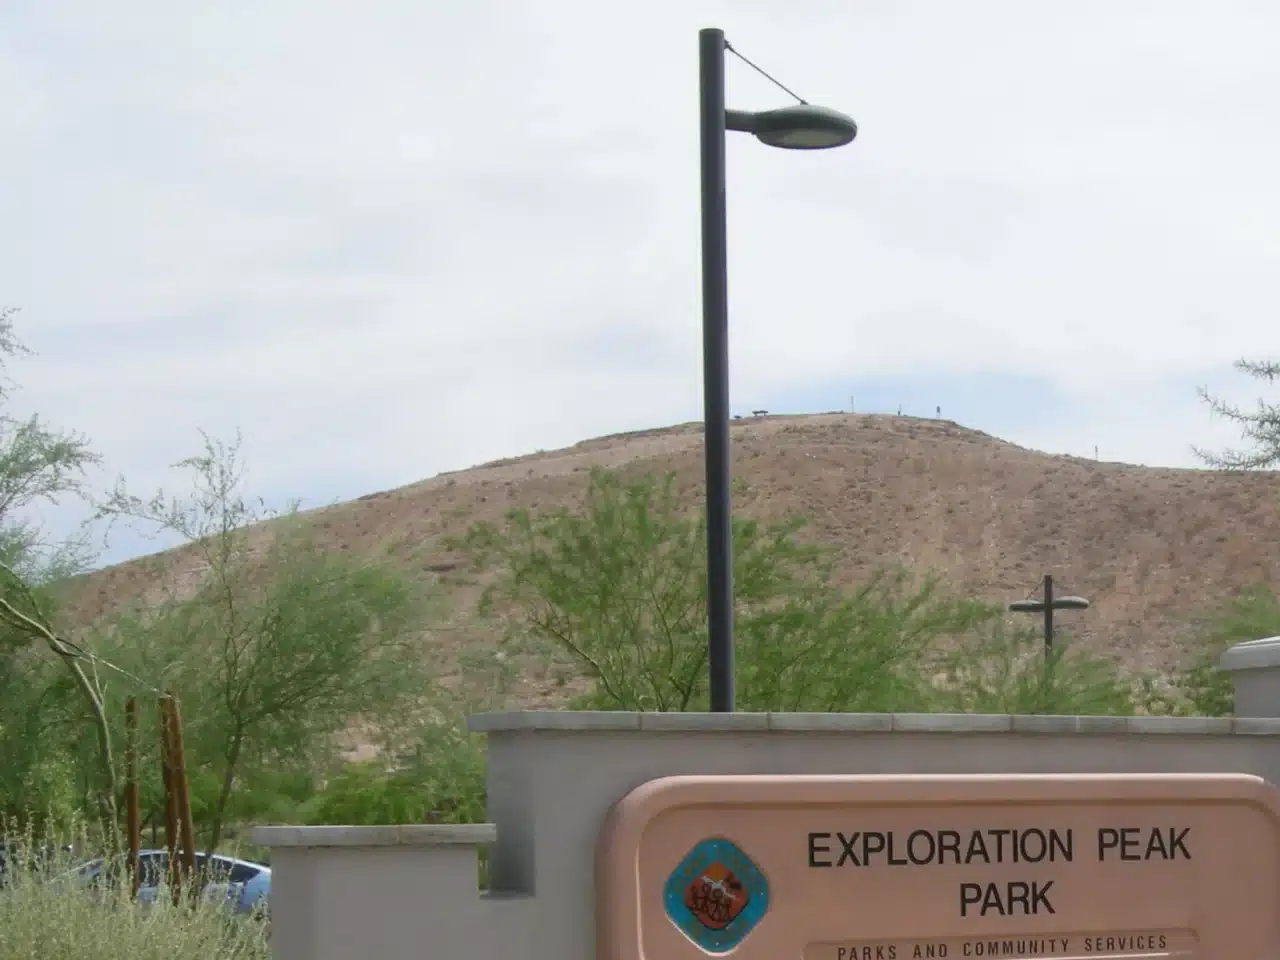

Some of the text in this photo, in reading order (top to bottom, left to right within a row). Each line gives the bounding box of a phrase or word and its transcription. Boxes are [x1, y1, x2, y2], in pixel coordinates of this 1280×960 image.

[807, 827, 1192, 867] EXPLORATION PEAK
[959, 881, 1055, 917] PARK
[837, 935, 1168, 960] PARKS AND COMMUNITY SERVICES
